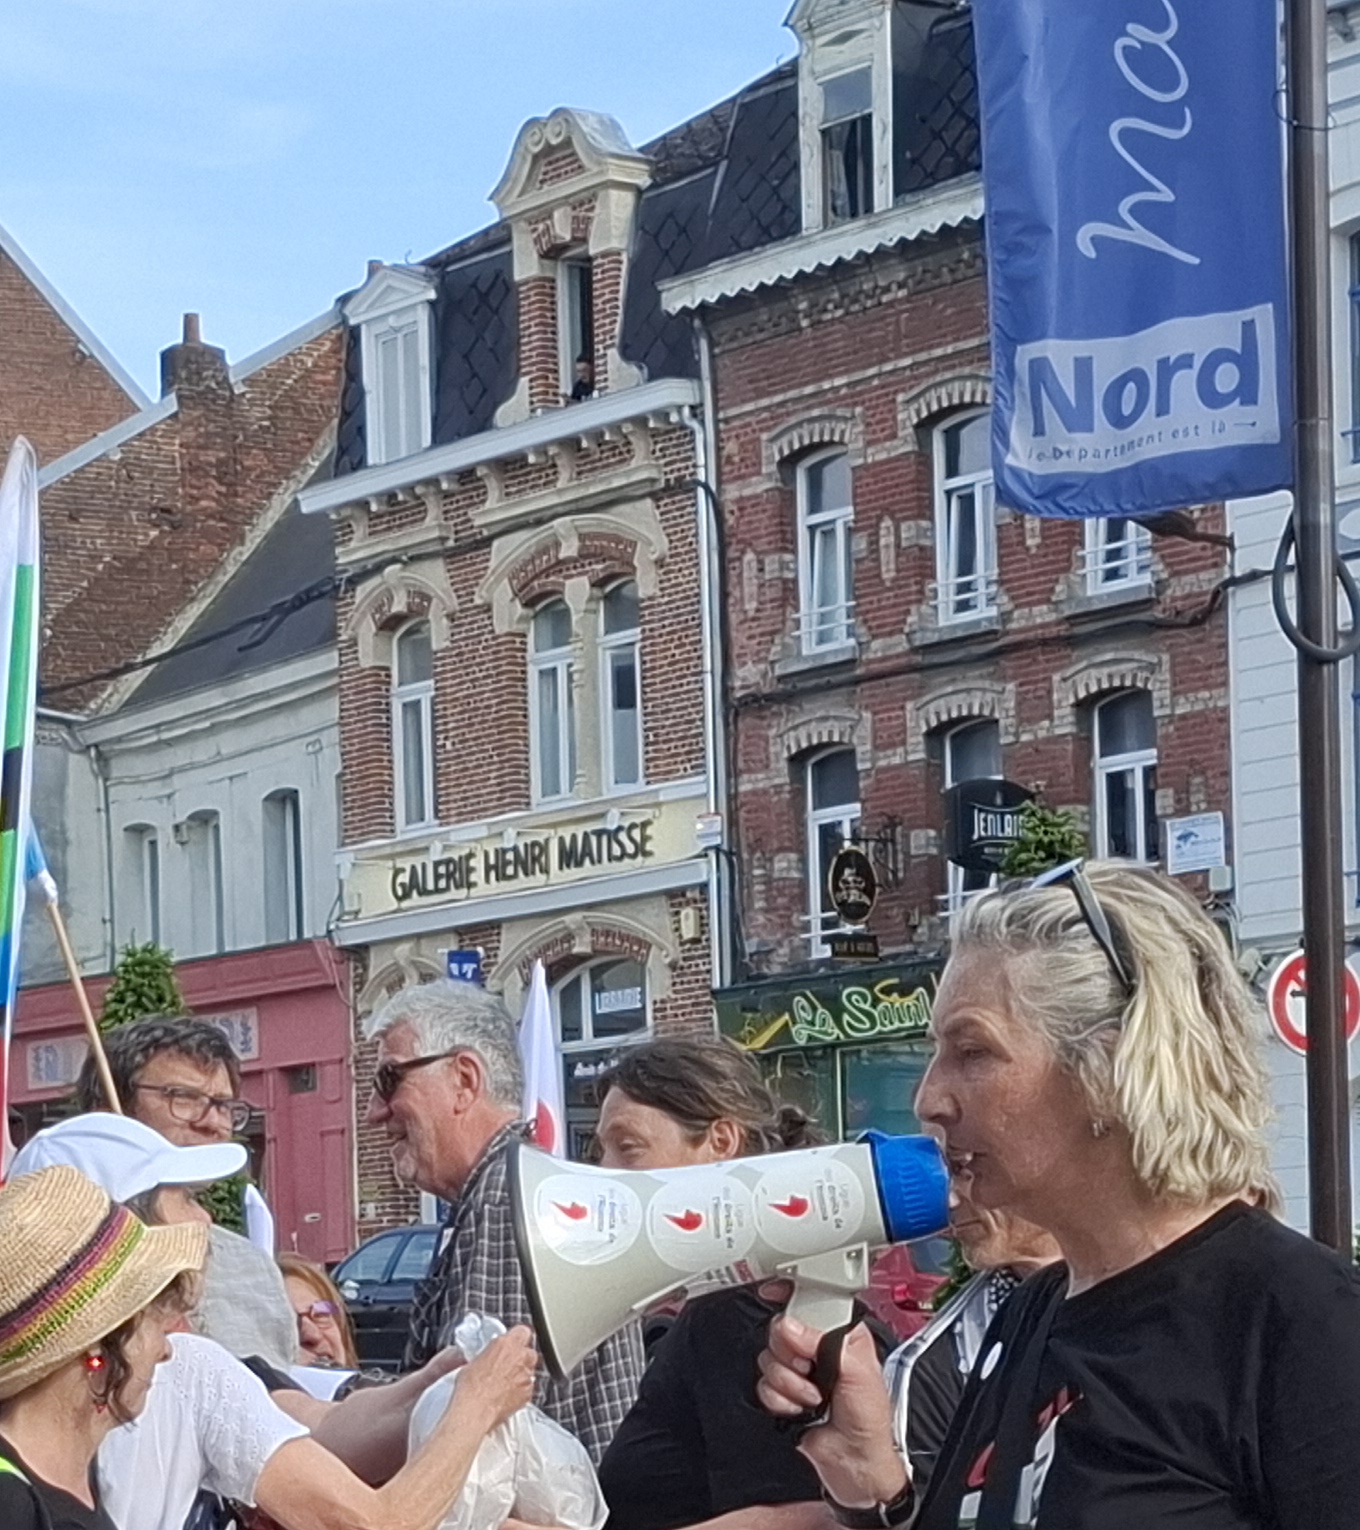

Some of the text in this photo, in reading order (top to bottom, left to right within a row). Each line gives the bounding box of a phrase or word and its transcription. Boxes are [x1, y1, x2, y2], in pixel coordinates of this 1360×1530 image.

[1028, 318, 1259, 438] Nord
[1171, 424, 1201, 439] est
[392, 818, 655, 901] GALERIE HENRI MATISSE
